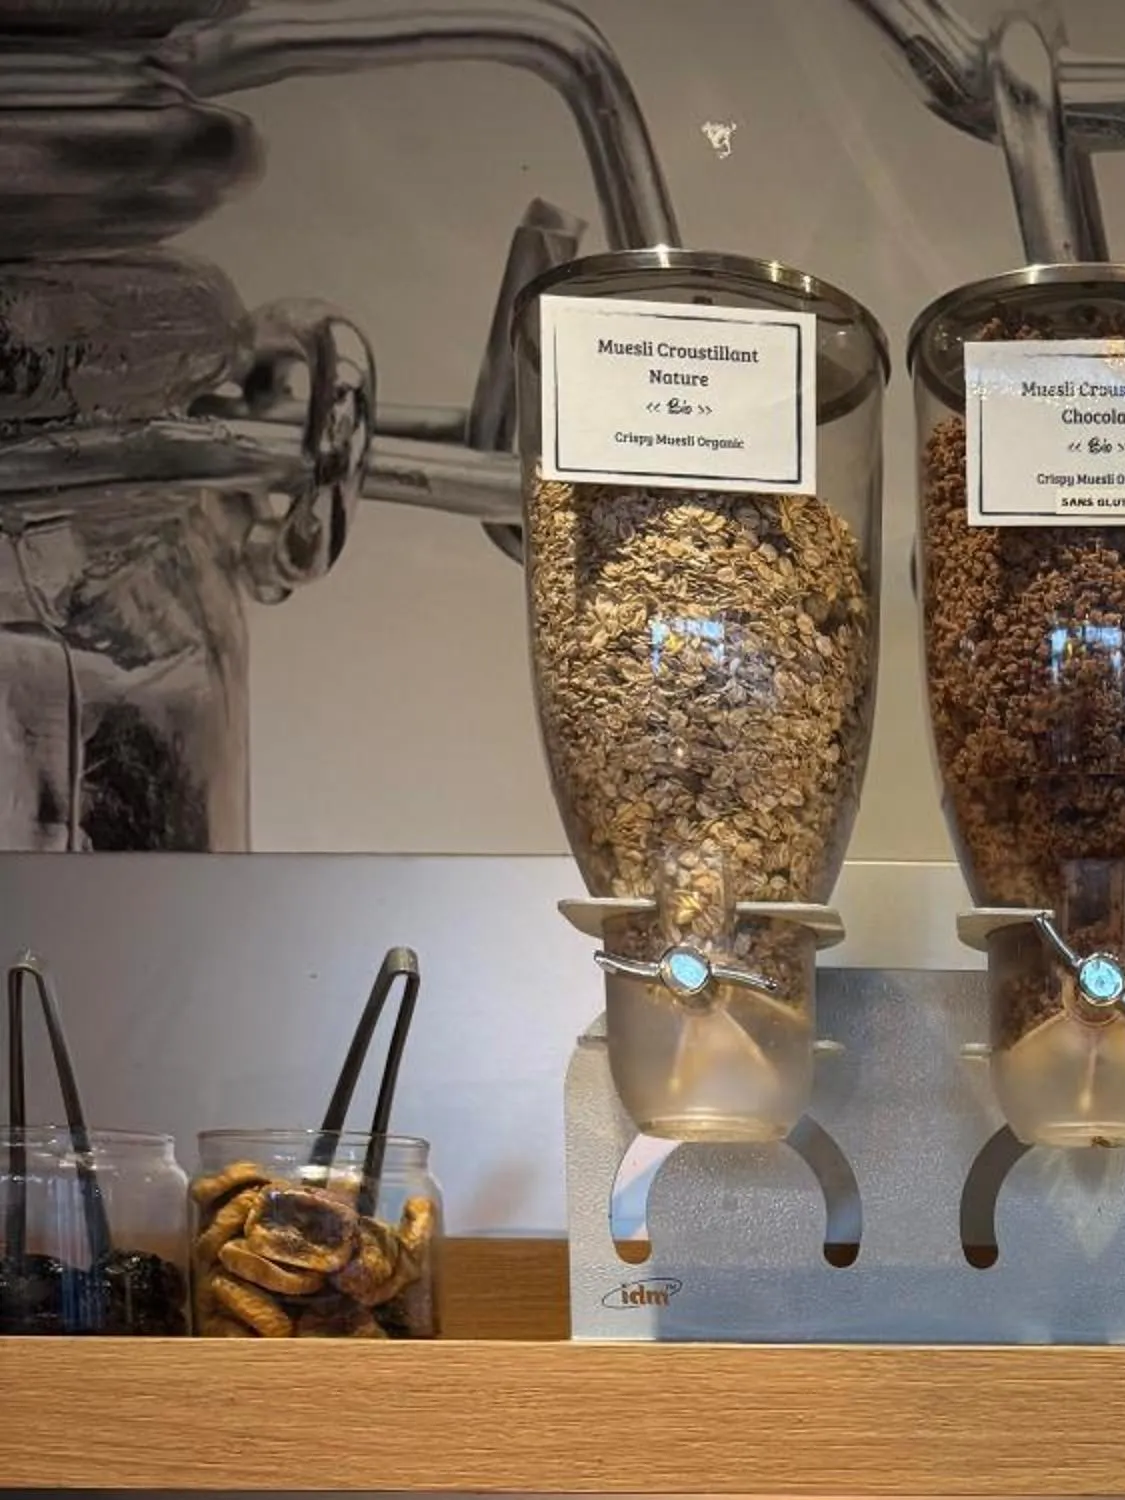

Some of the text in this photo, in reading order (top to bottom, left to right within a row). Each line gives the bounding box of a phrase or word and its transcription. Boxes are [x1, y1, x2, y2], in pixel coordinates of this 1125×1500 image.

[597, 339, 760, 363] Muesli Croustillant
[649, 370, 709, 387] Nature
[1021, 381, 1075, 397] Muesli
[614, 431, 745, 450] Crispy Muesli Organic
[1036, 473, 1075, 487] Crispy
[1076, 474, 1115, 485] Muesli
[1061, 497, 1094, 507] SANS
